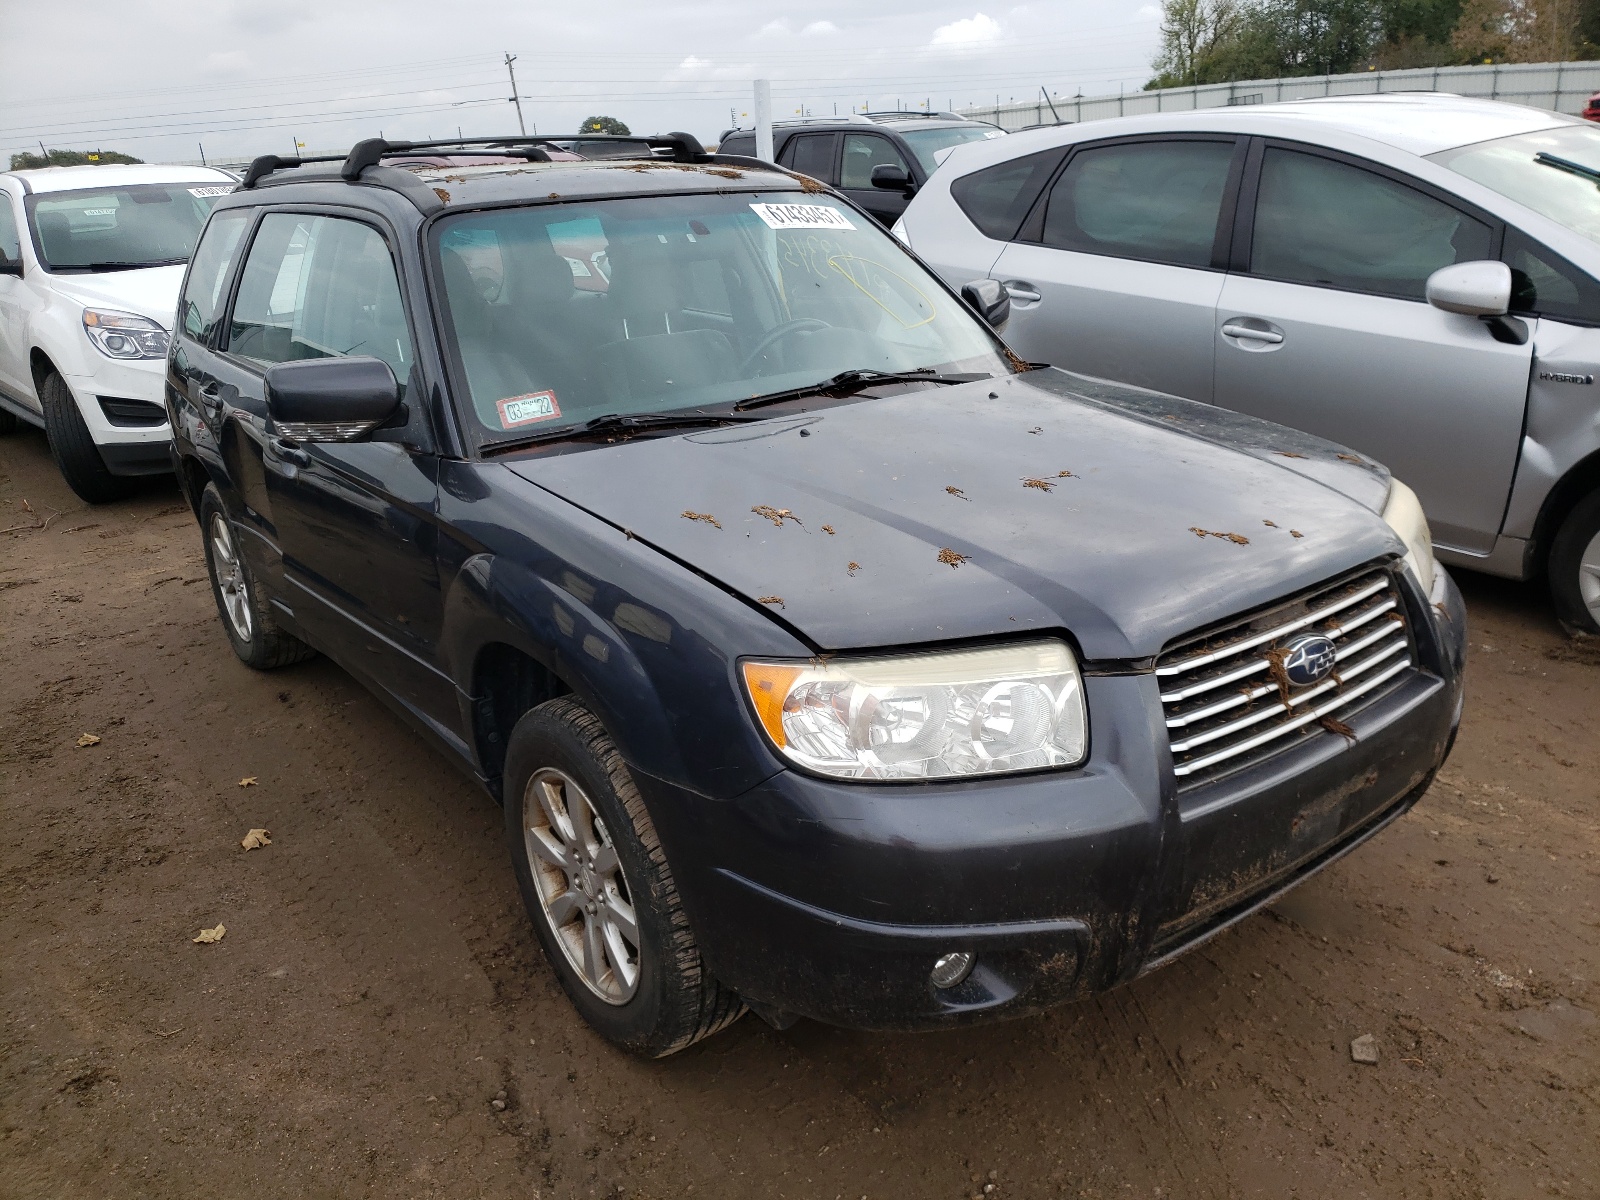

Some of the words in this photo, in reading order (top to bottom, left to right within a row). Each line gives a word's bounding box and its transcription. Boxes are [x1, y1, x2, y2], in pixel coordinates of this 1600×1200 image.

[1540, 371, 1584, 384] HYBRID
[507, 403, 522, 420] 03
[537, 397, 552, 414] 22
